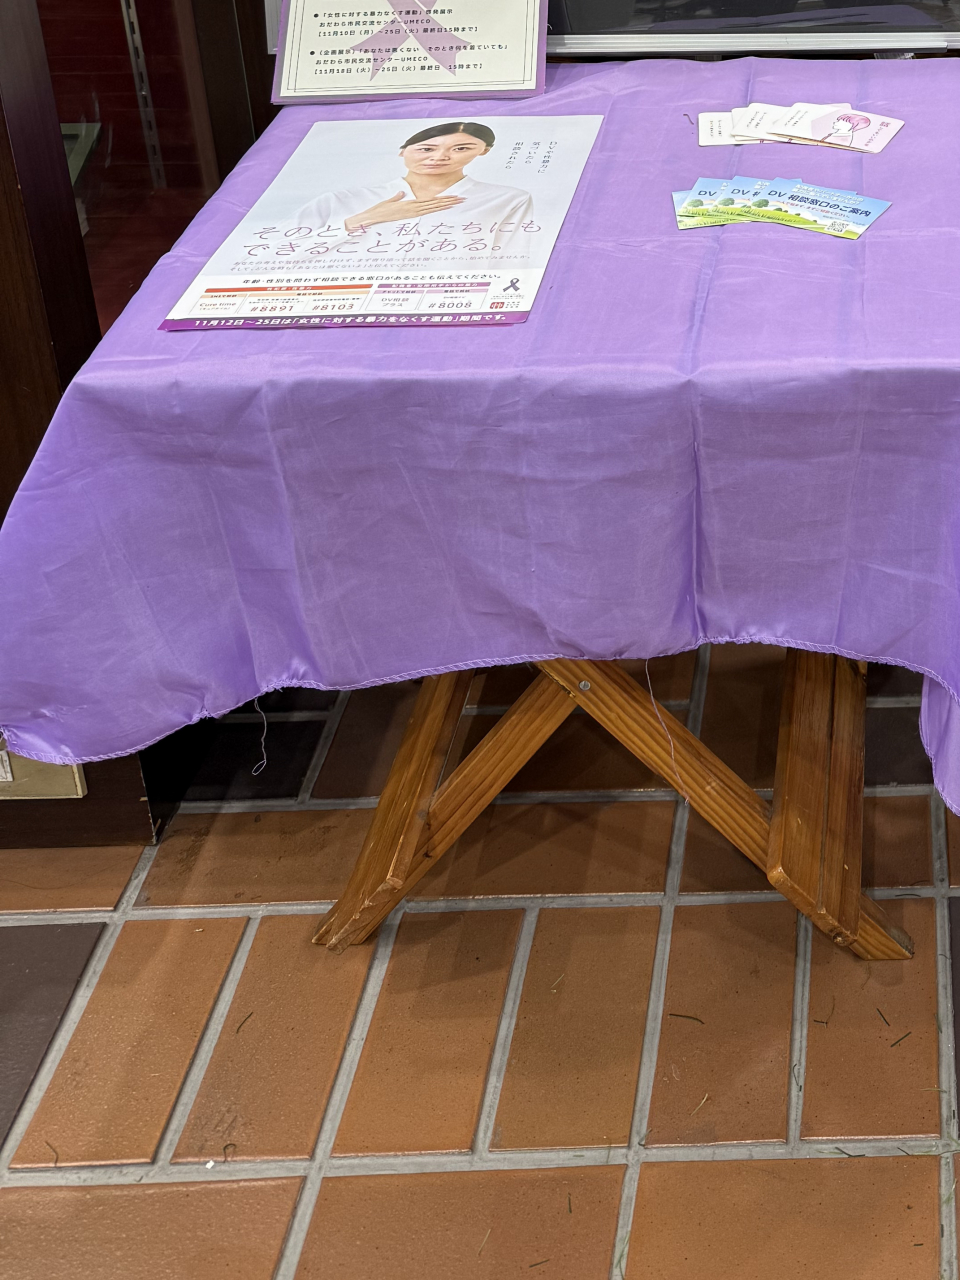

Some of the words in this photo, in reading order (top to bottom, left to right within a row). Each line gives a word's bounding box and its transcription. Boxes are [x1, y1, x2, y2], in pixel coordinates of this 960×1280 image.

[767, 190, 787, 198] DV
[788, 194, 871, 218] 相談窓口のご案内
[252, 220, 543, 240] そのとき、私たちにも
[243, 237, 503, 256] できることがある。
